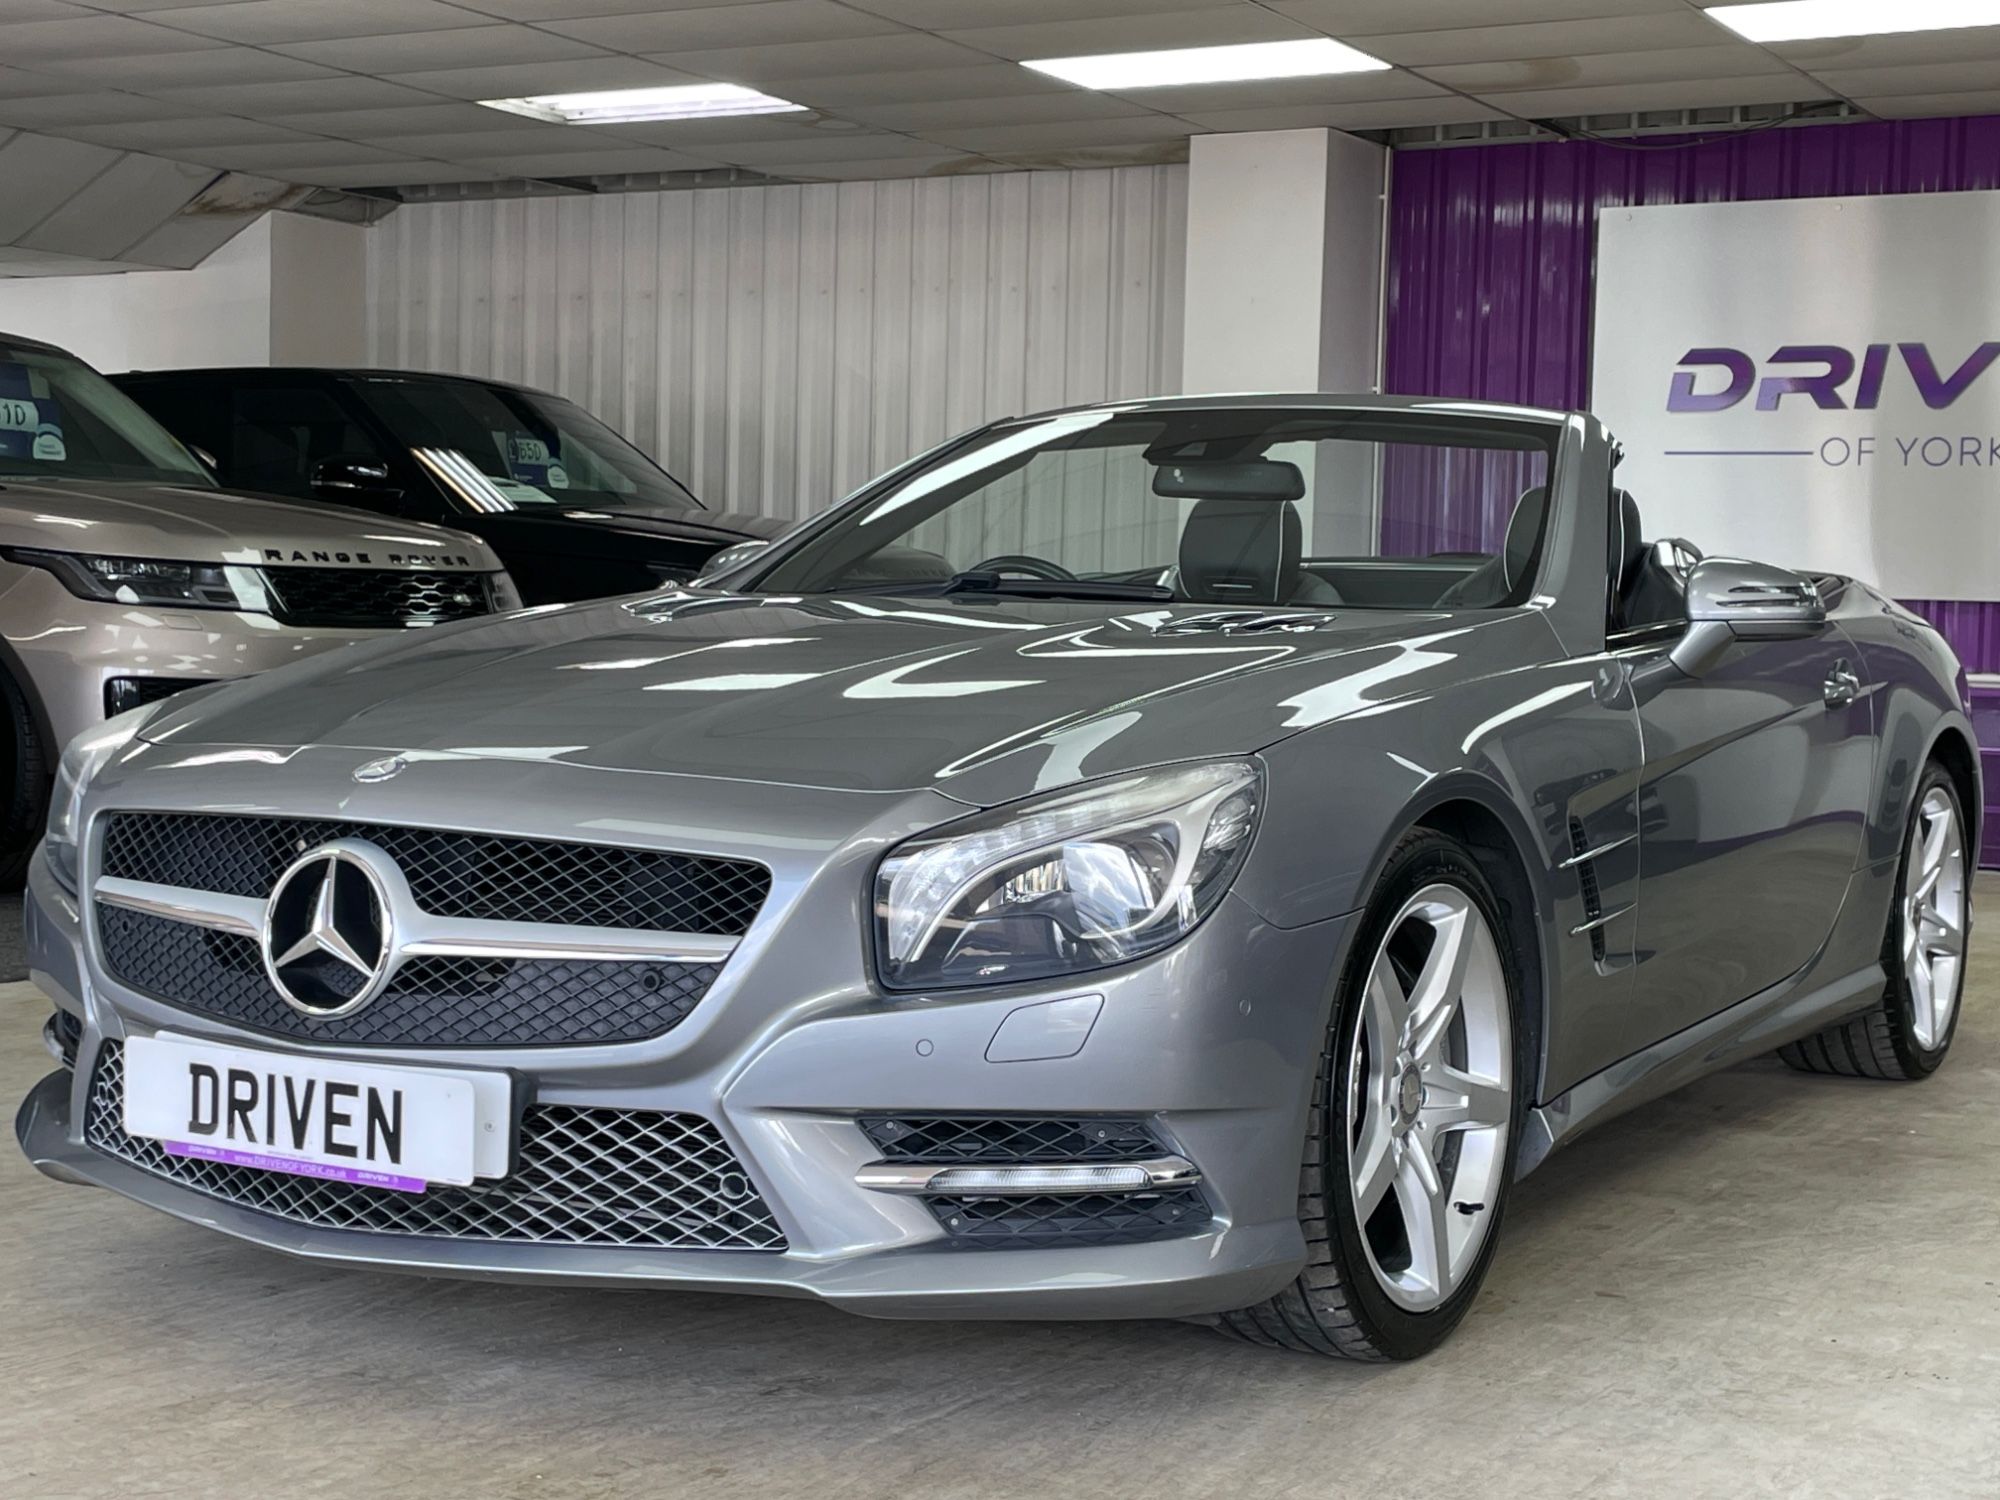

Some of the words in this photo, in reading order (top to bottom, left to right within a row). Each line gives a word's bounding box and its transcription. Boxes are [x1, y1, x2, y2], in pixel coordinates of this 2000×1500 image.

[1667, 341, 2000, 412] DRIV
[1820, 437, 1875, 466] OF
[265, 549, 371, 564] RANGE
[389, 553, 470, 567] ROVER
[188, 1063, 402, 1165] DRIVEN
